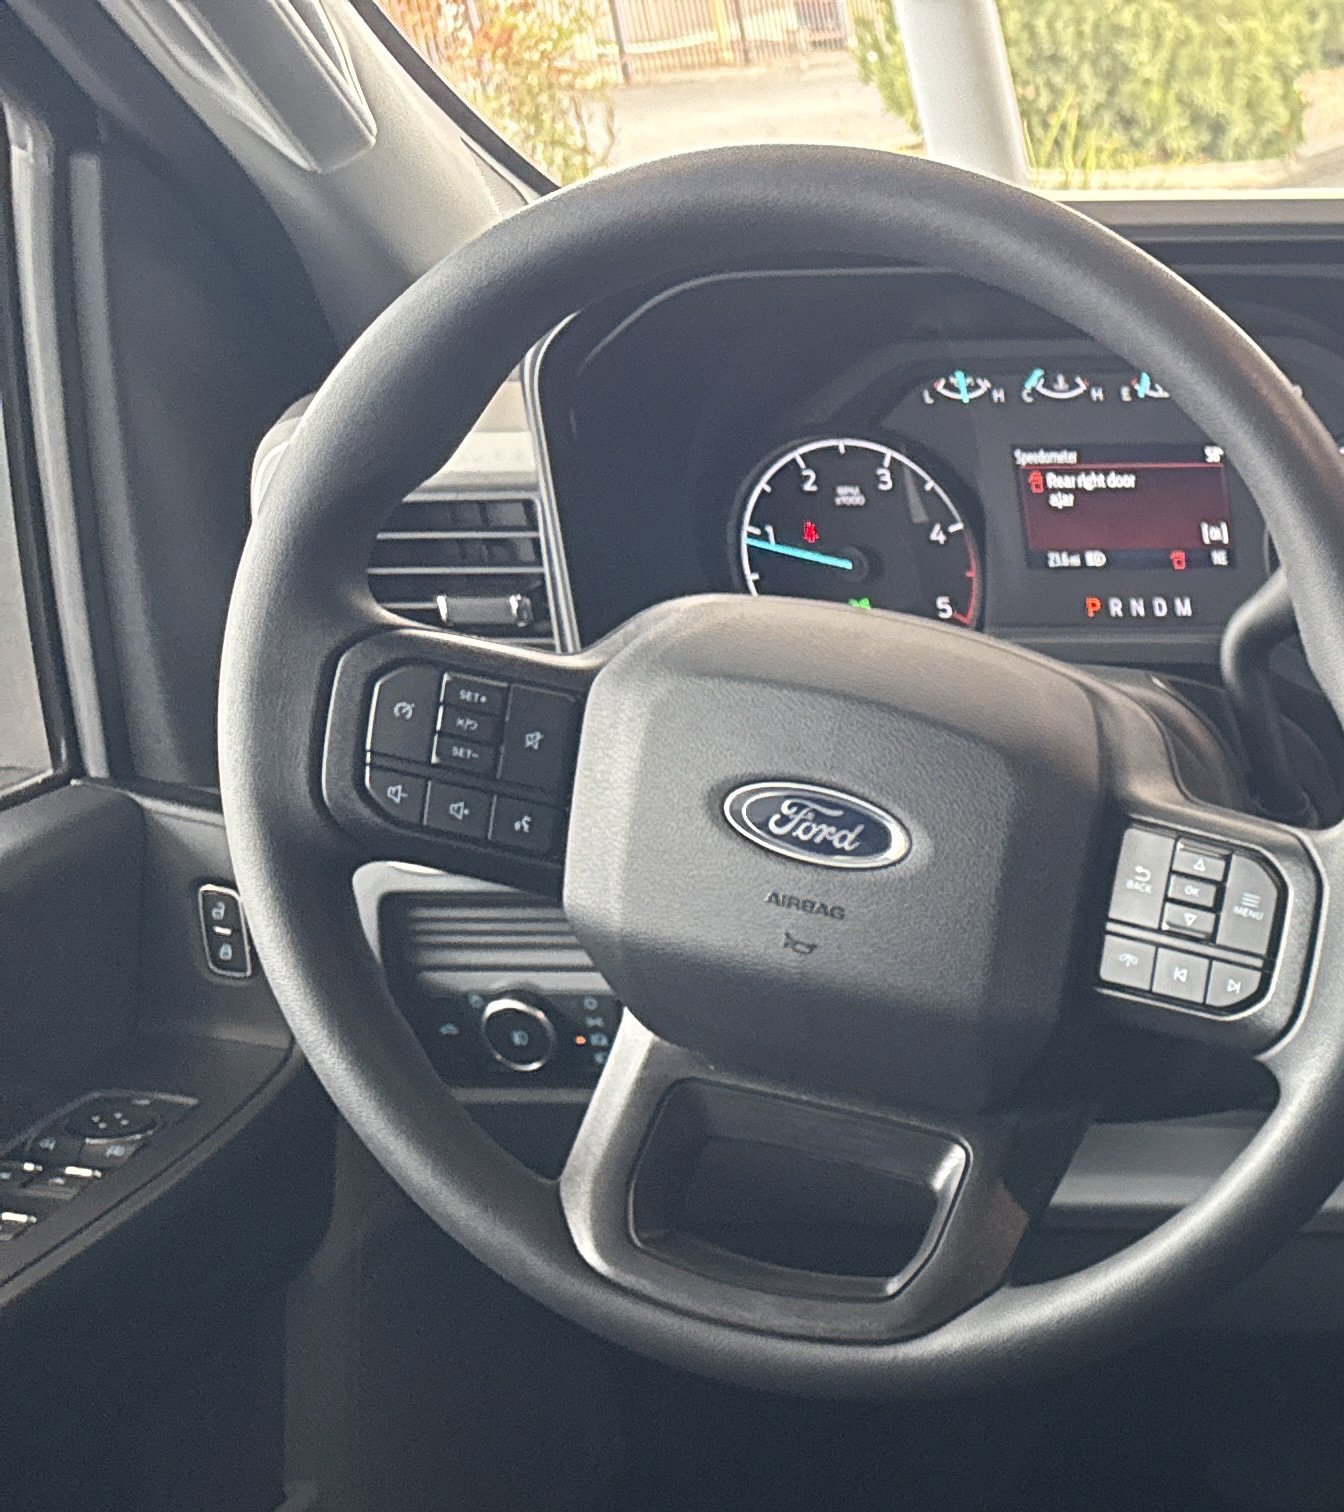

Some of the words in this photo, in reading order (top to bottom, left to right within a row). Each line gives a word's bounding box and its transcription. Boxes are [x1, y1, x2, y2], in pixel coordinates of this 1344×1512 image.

[923, 389, 935, 404] L
[991, 388, 1006, 403] H
[1021, 388, 1034, 403] C
[1090, 388, 1105, 402] H
[1121, 387, 1132, 402] E
[802, 468, 818, 492] 2
[876, 468, 893, 491] 3
[1045, 471, 1076, 489] Rear
[1077, 471, 1106, 491] right
[1107, 471, 1136, 489] door
[764, 524, 775, 545] 1
[929, 524, 947, 545] 4
[935, 596, 953, 619] 5
[1086, 597, 1101, 617] P
[1108, 597, 1123, 617] R
[1130, 597, 1145, 617] N
[1152, 598, 1168, 617] D
[1174, 598, 1193, 617] M
[768, 799, 865, 851] Ford
[1126, 879, 1153, 894] BACK
[1184, 885, 1201, 898] OK
[763, 891, 846, 921] AIRBAG
[1233, 905, 1265, 921] MENU
